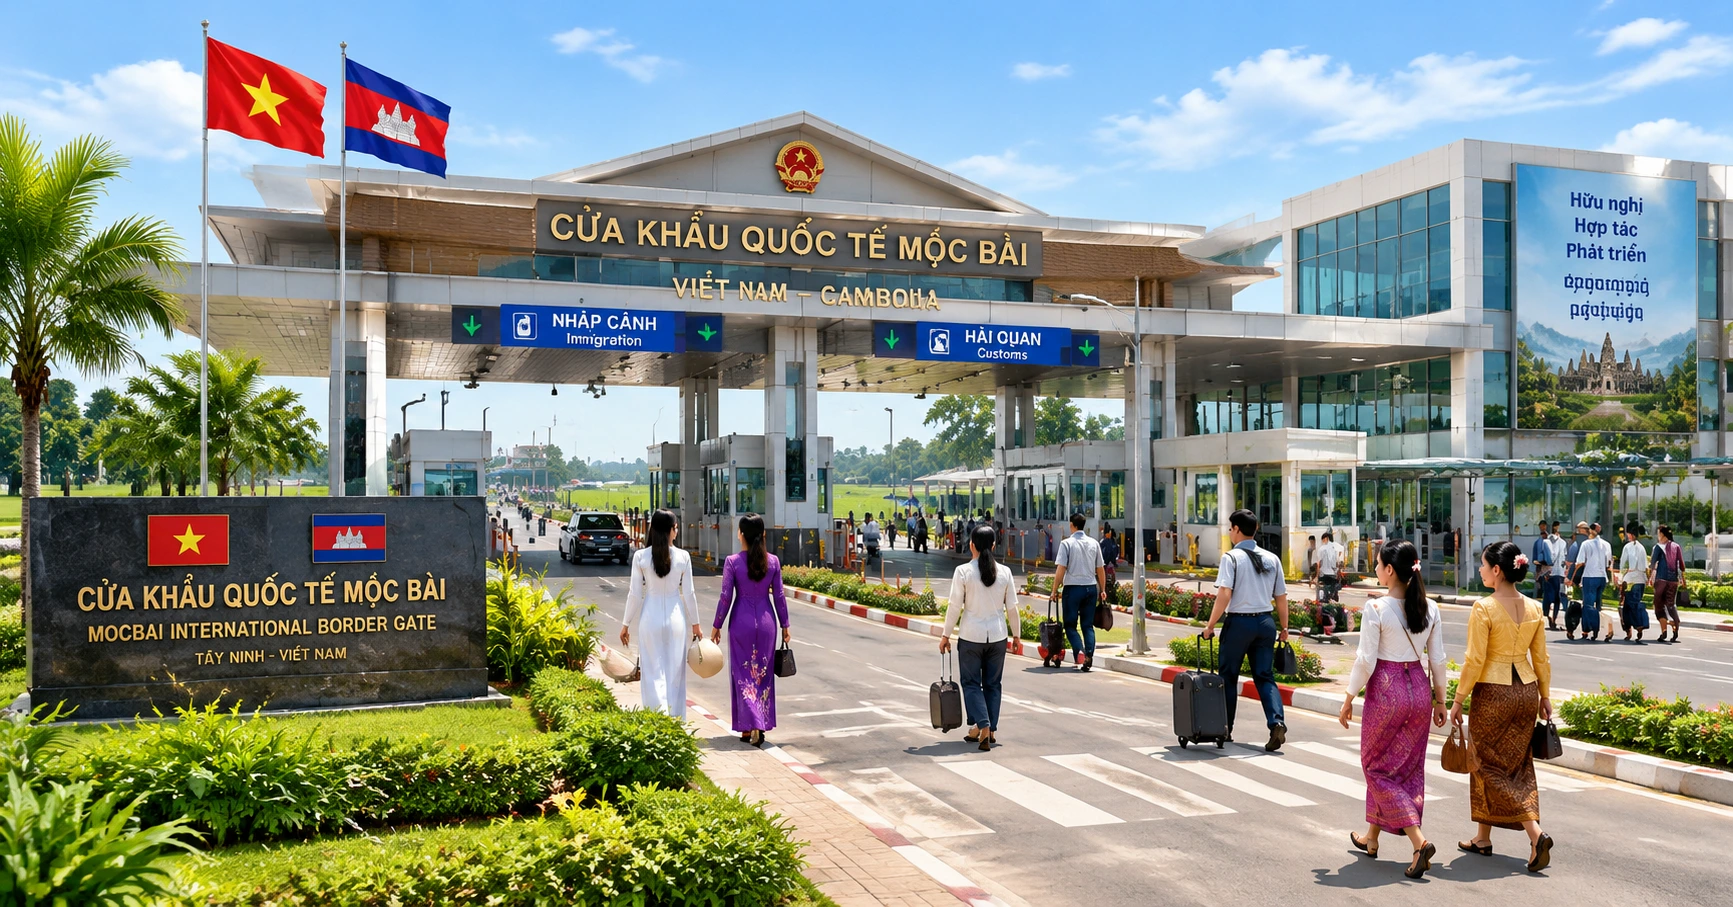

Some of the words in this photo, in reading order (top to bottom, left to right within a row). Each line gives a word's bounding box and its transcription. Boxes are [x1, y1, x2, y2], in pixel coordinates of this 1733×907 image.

[1570, 191, 1604, 210] Hữu
[1609, 196, 1644, 216] nghị
[550, 204, 625, 244] CỬA
[637, 209, 729, 251] KHẨU
[741, 216, 837, 257] QUỐC
[847, 224, 888, 259] TẾ
[979, 232, 1027, 266] BÀI
[1575, 217, 1608, 238] Hợp
[739, 281, 787, 303] NAM
[566, 332, 642, 348] Immigration
[977, 347, 1028, 360] Customs
[77, 578, 135, 612] CỬA
[143, 573, 215, 610] KHẨU
[223, 571, 297, 608] QUỐC
[304, 571, 336, 605] TẾ
[344, 572, 399, 609] MỘC
[407, 571, 446, 601] BÀI
[88, 623, 163, 643] MOCBAI
[170, 619, 313, 640] INTERNATIONAL
[318, 615, 388, 635] BORDER
[393, 614, 437, 631] GATE
[229, 649, 265, 664] NINH
[314, 646, 347, 660] NAM
